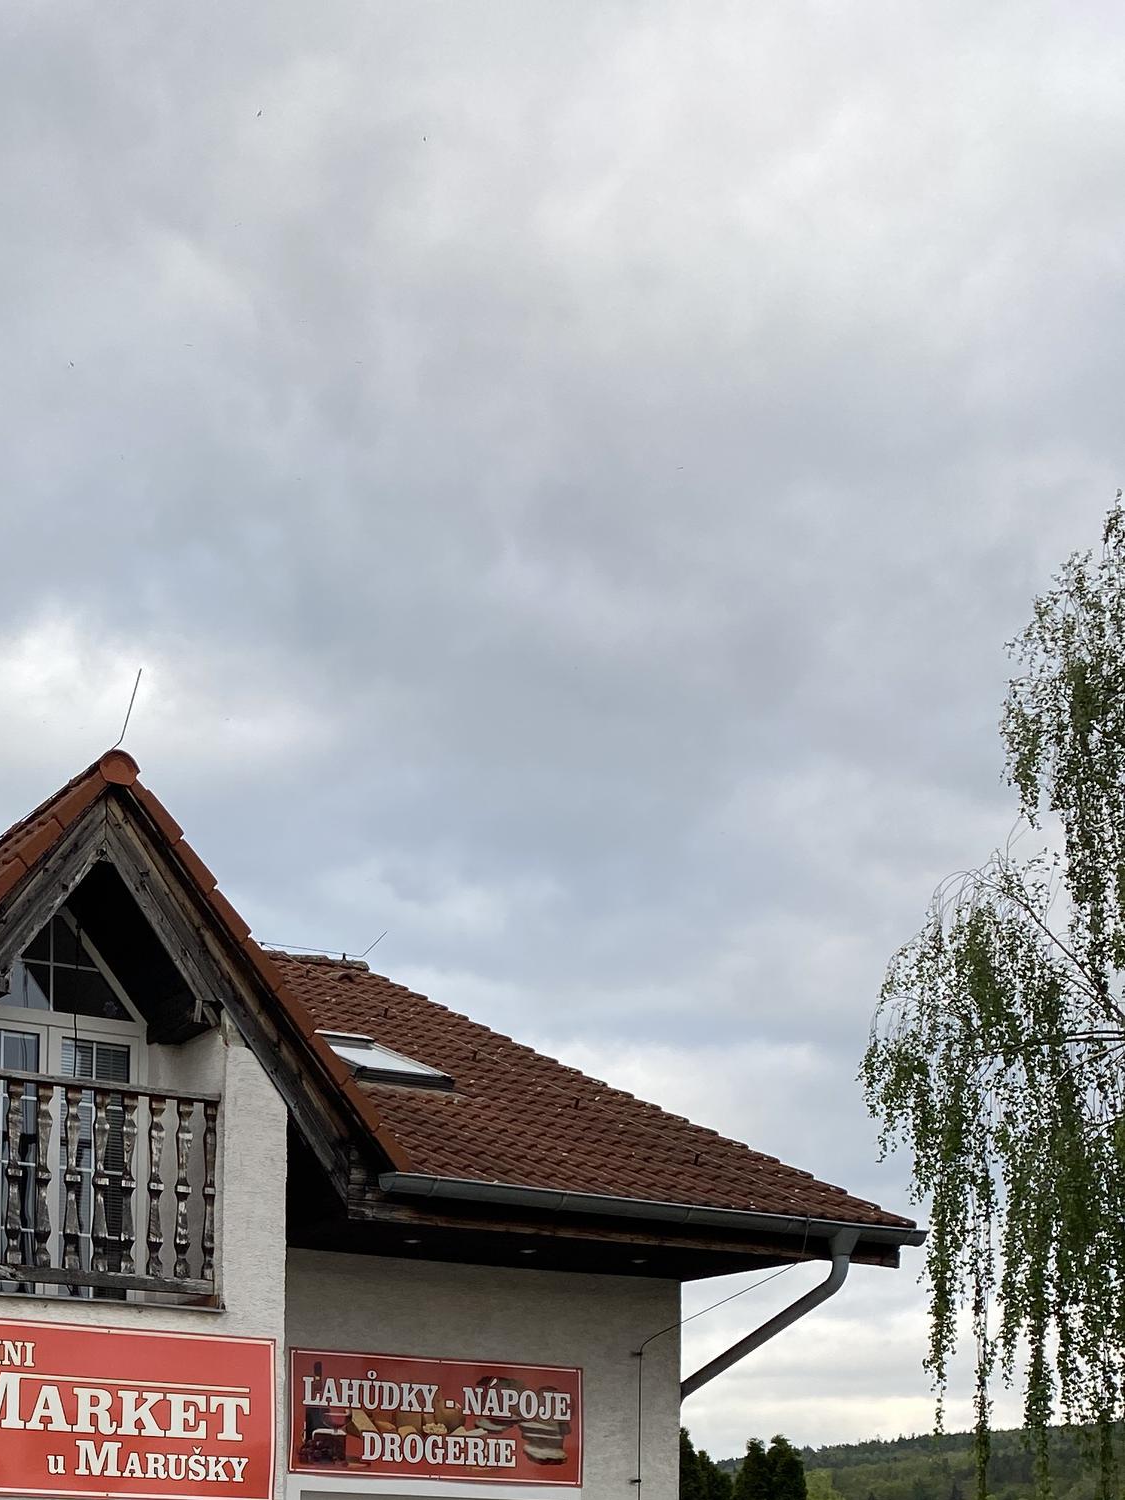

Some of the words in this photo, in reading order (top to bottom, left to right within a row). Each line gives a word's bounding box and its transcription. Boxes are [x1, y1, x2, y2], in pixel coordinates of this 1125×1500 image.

[302, 1370, 438, 1414] LAHŮDKY
[462, 1378, 571, 1421] NÁPOJE
[47, 1453, 66, 1475] u
[74, 1439, 249, 1483] MARUŠKY
[361, 1431, 516, 1468] DROGERIE
